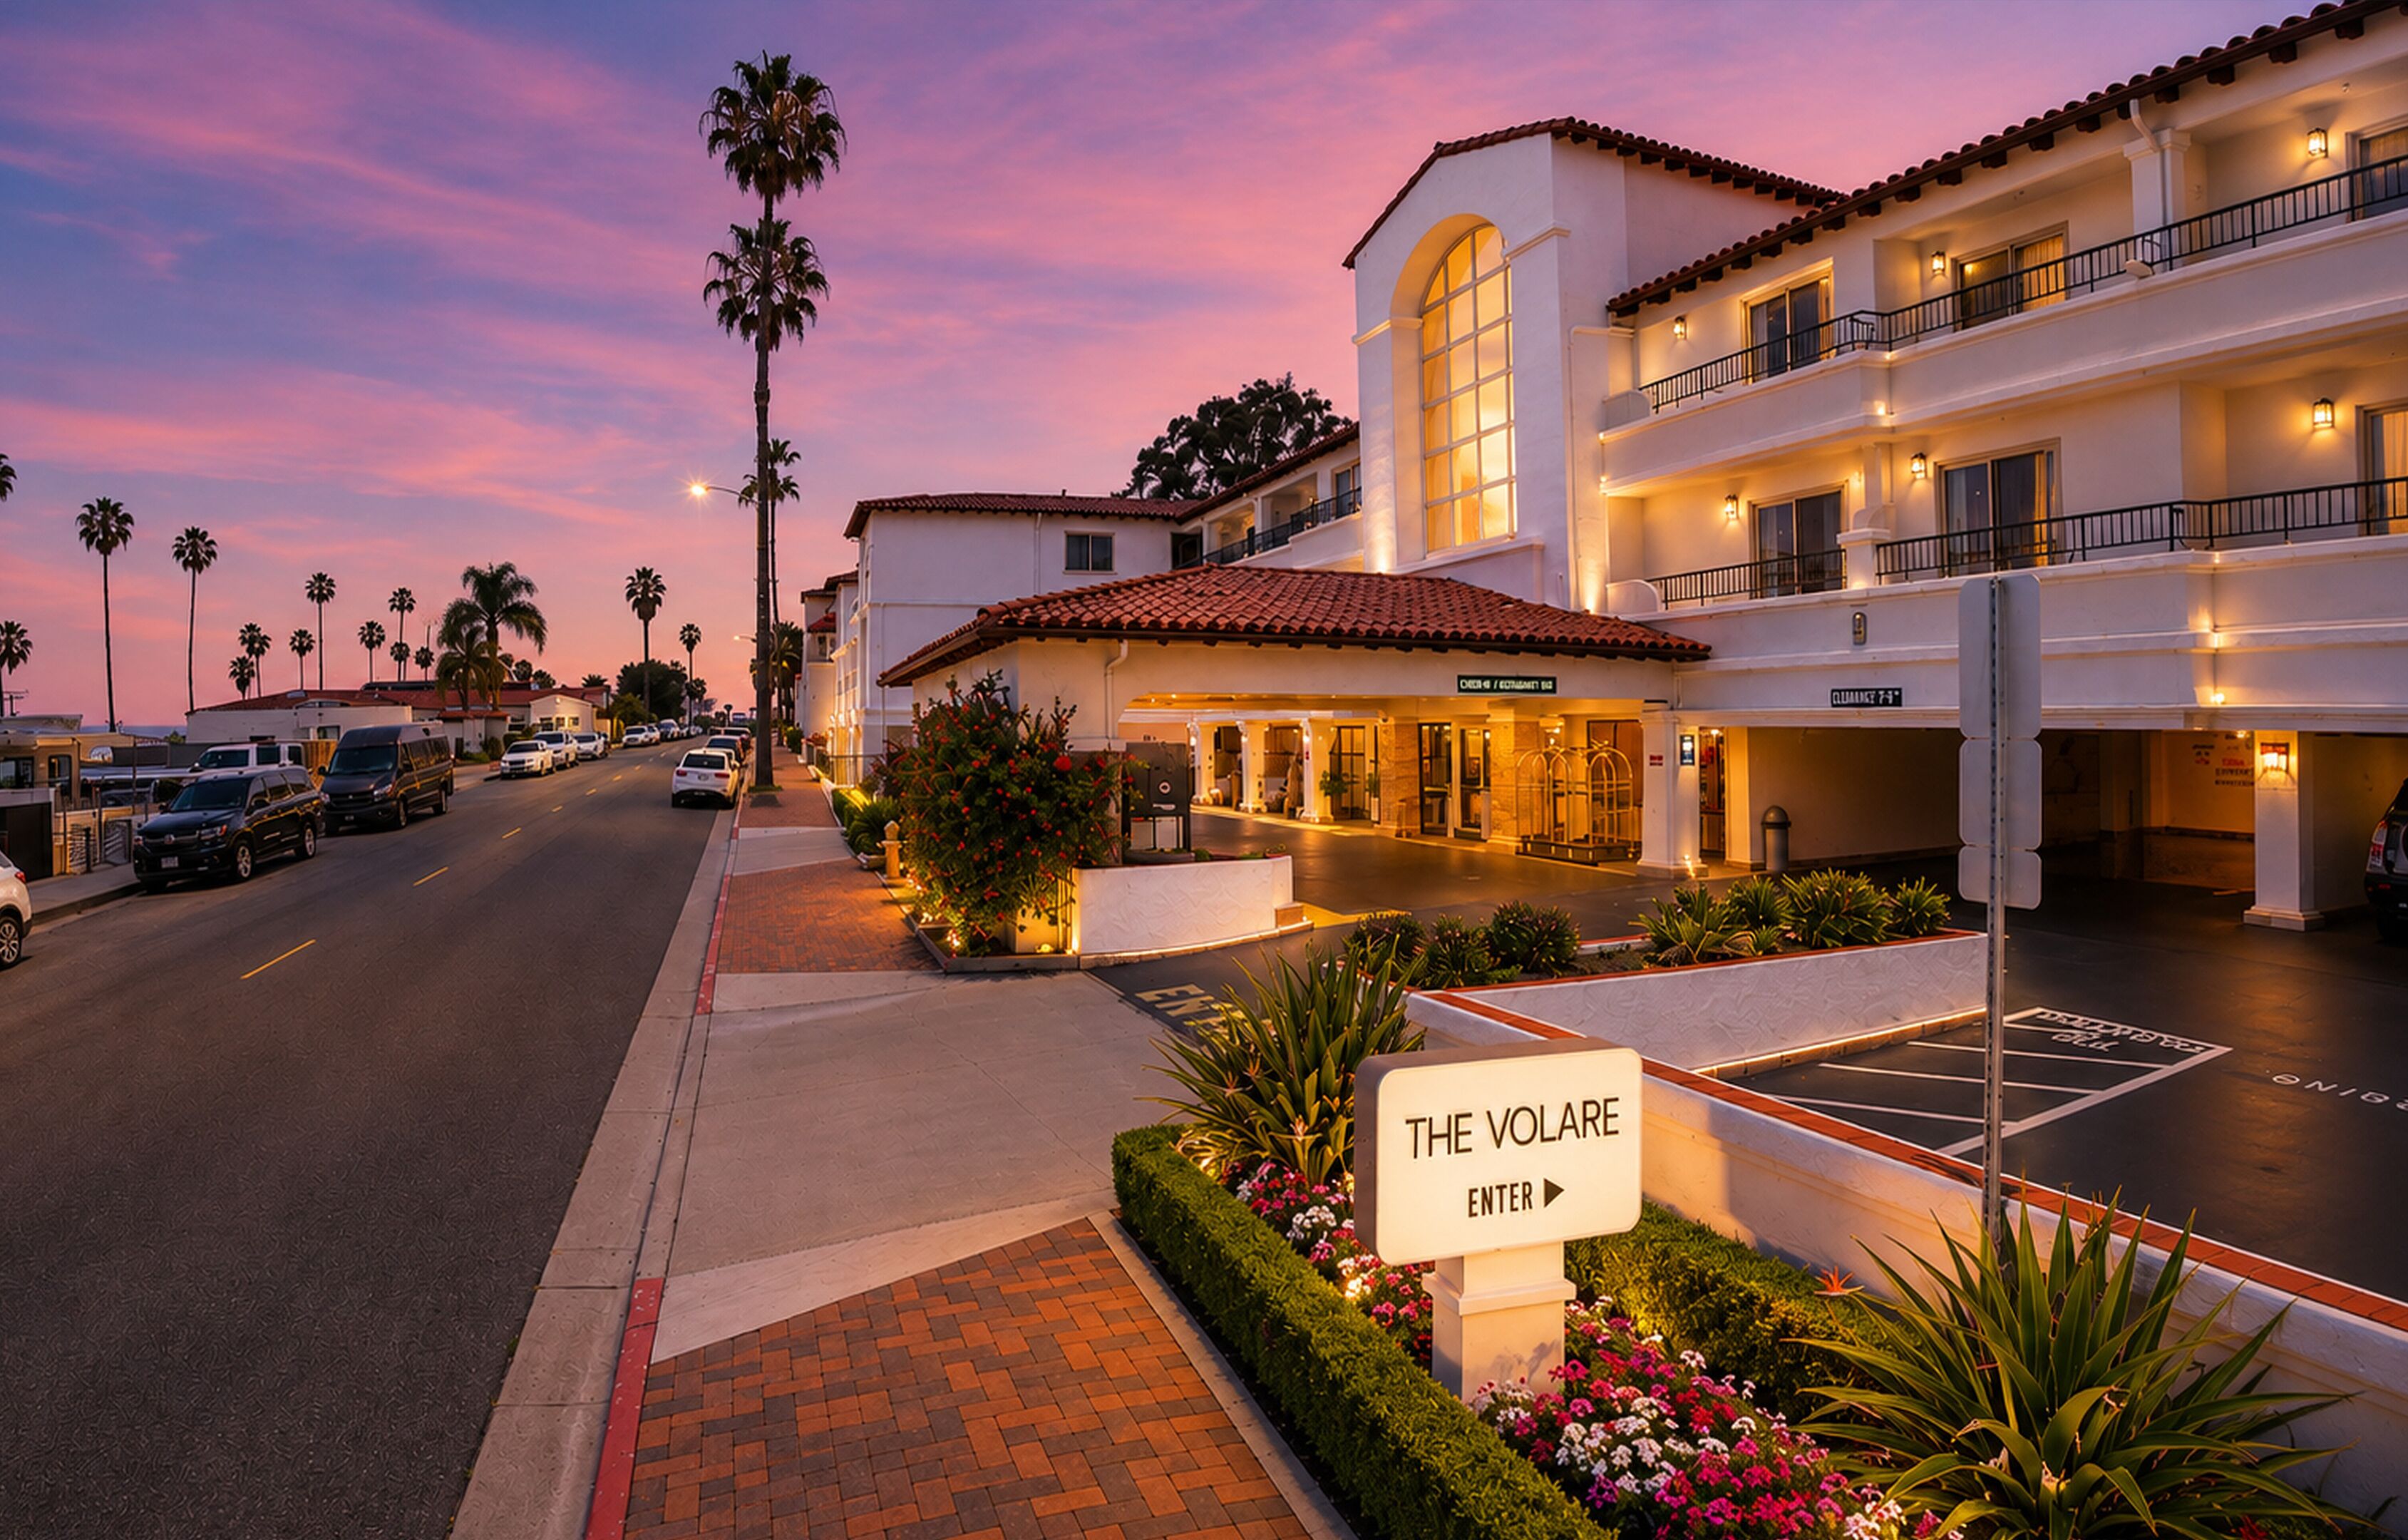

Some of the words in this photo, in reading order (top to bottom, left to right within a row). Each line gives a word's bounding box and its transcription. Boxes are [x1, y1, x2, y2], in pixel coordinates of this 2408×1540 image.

[1405, 1112, 1473, 1159] THE
[1486, 1097, 1620, 1149] VOLARE
[1468, 1181, 1533, 1218] ENTER
